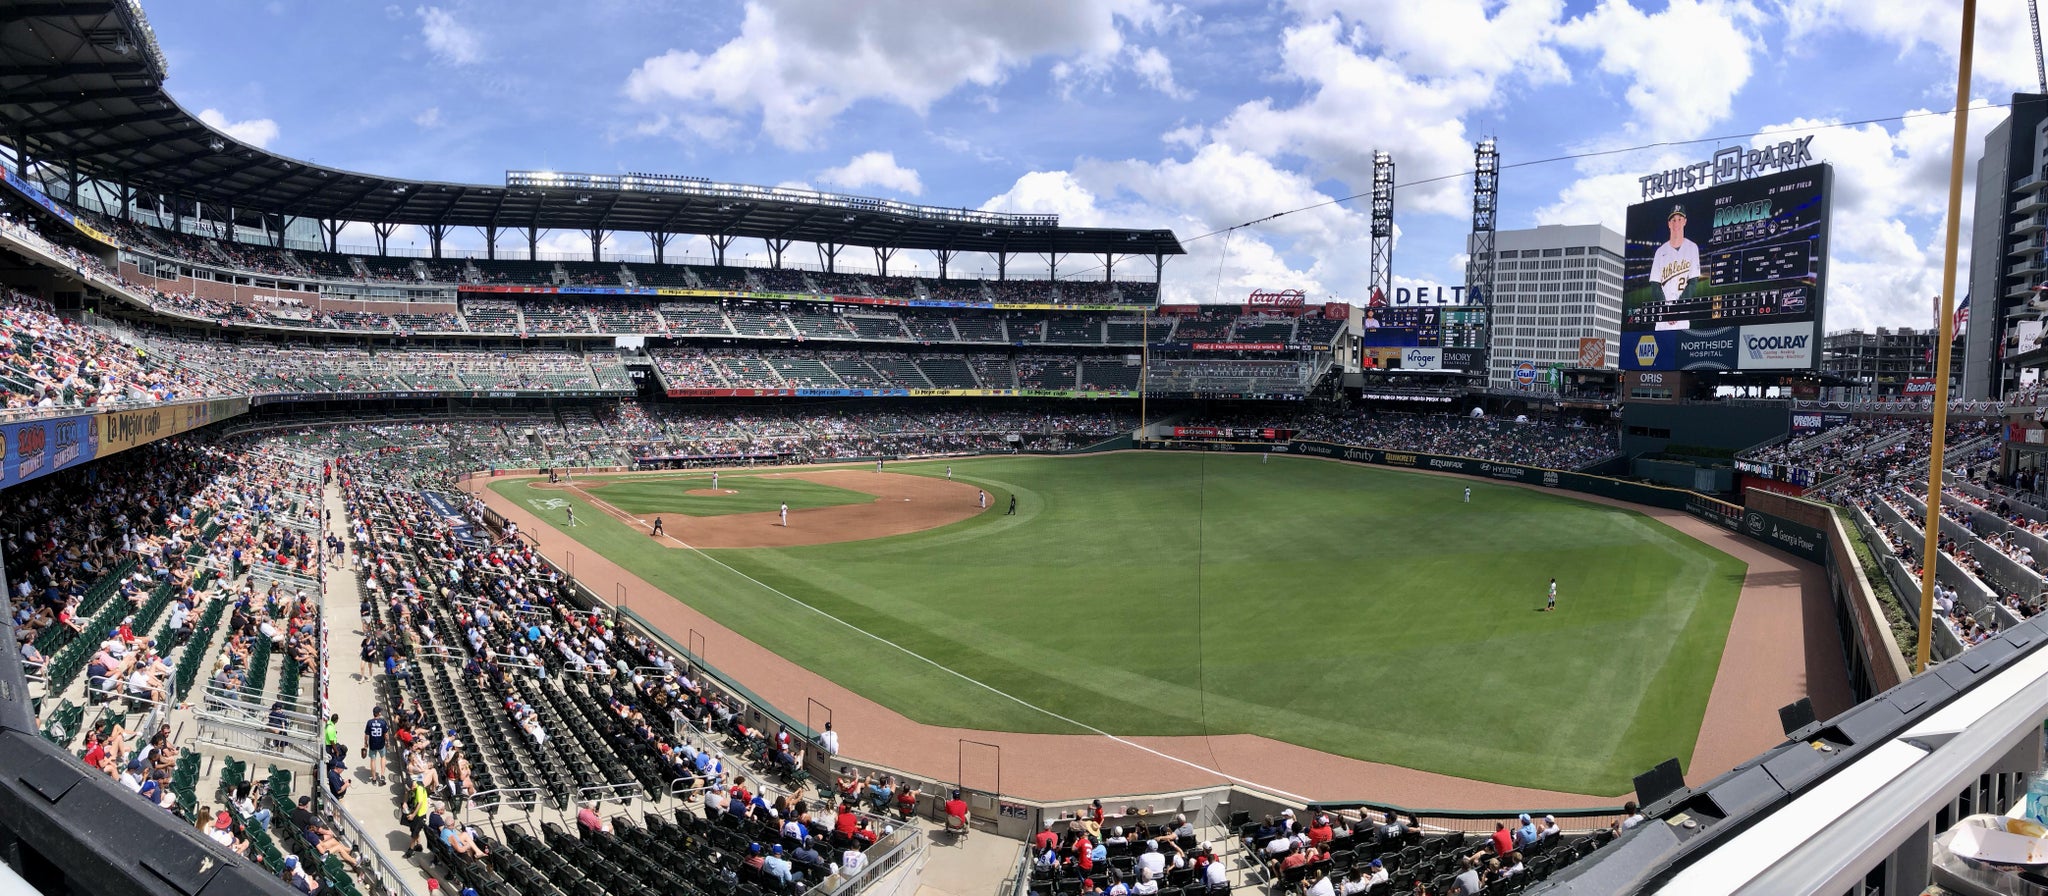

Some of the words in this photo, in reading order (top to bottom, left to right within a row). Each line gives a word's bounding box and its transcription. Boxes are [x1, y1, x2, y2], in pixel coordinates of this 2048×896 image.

[1639, 161, 1710, 197] TRUIST
[1747, 135, 1814, 174] PARK
[1796, 180, 1812, 188] FIELD
[1715, 196, 1732, 206] BRENT
[1714, 199, 1772, 228] ROOKER
[1396, 286, 1484, 304] DELTA
[1425, 314, 1435, 324] 77
[1681, 340, 1733, 350] NORTHSIDE
[1749, 335, 1809, 350] COOLRAY
[1580, 340, 1604, 366] HOME
[1639, 345, 1655, 357] NAPA
[1408, 350, 1435, 367] Kroger
[1590, 350, 1605, 366] DEPOT
[1640, 374, 1662, 383] ORIS
[1906, 382, 1936, 392] RaceTra
[107, 415, 117, 443] La
[120, 412, 142, 446] Mejor
[144, 409, 160, 437] radio
[1344, 448, 1374, 462] xfinity
[1386, 453, 1417, 463] QUIKRETE
[1430, 459, 1463, 468] EQUIFAX
[1492, 466, 1524, 476] HYUNDAI
[1780, 530, 1797, 546] Georgia
[1798, 537, 1814, 551] Power
[371, 728, 382, 736] 28
